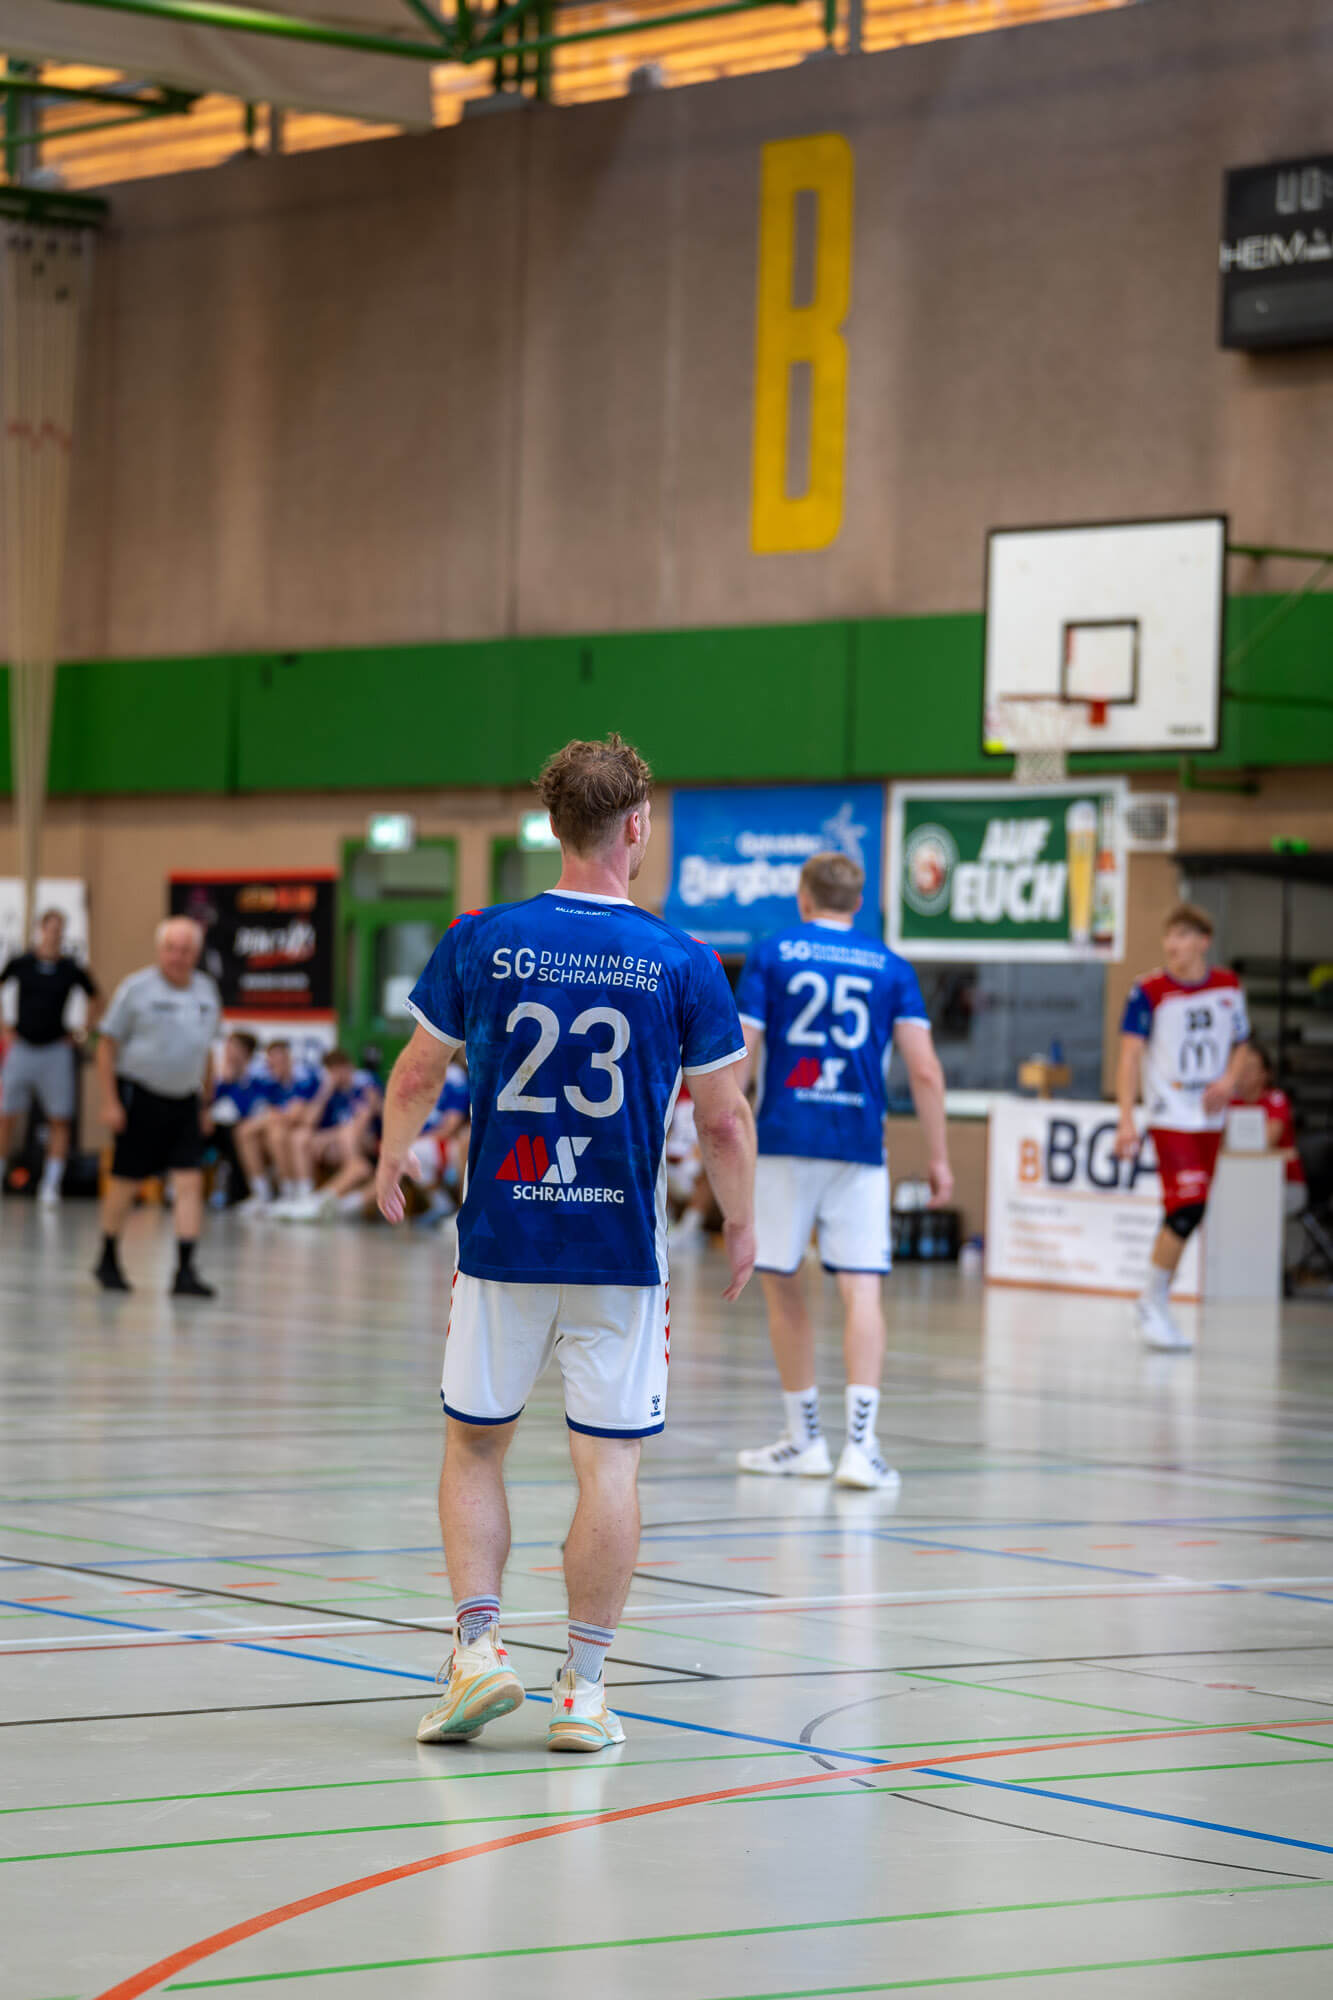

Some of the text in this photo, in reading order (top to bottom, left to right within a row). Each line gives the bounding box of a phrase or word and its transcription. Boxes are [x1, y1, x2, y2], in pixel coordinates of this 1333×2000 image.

[752, 132, 855, 554] B
[979, 817, 1053, 863] AUF
[951, 861, 1069, 923] EUCH
[491, 947, 663, 980] SG DUNNINGEN
[779, 940, 812, 962] SG
[536, 967, 659, 993] SCHRAMBERG
[786, 970, 873, 1050] 25
[496, 1001, 631, 1119] 23
[512, 1185, 625, 1204] SCHRAMBERG
